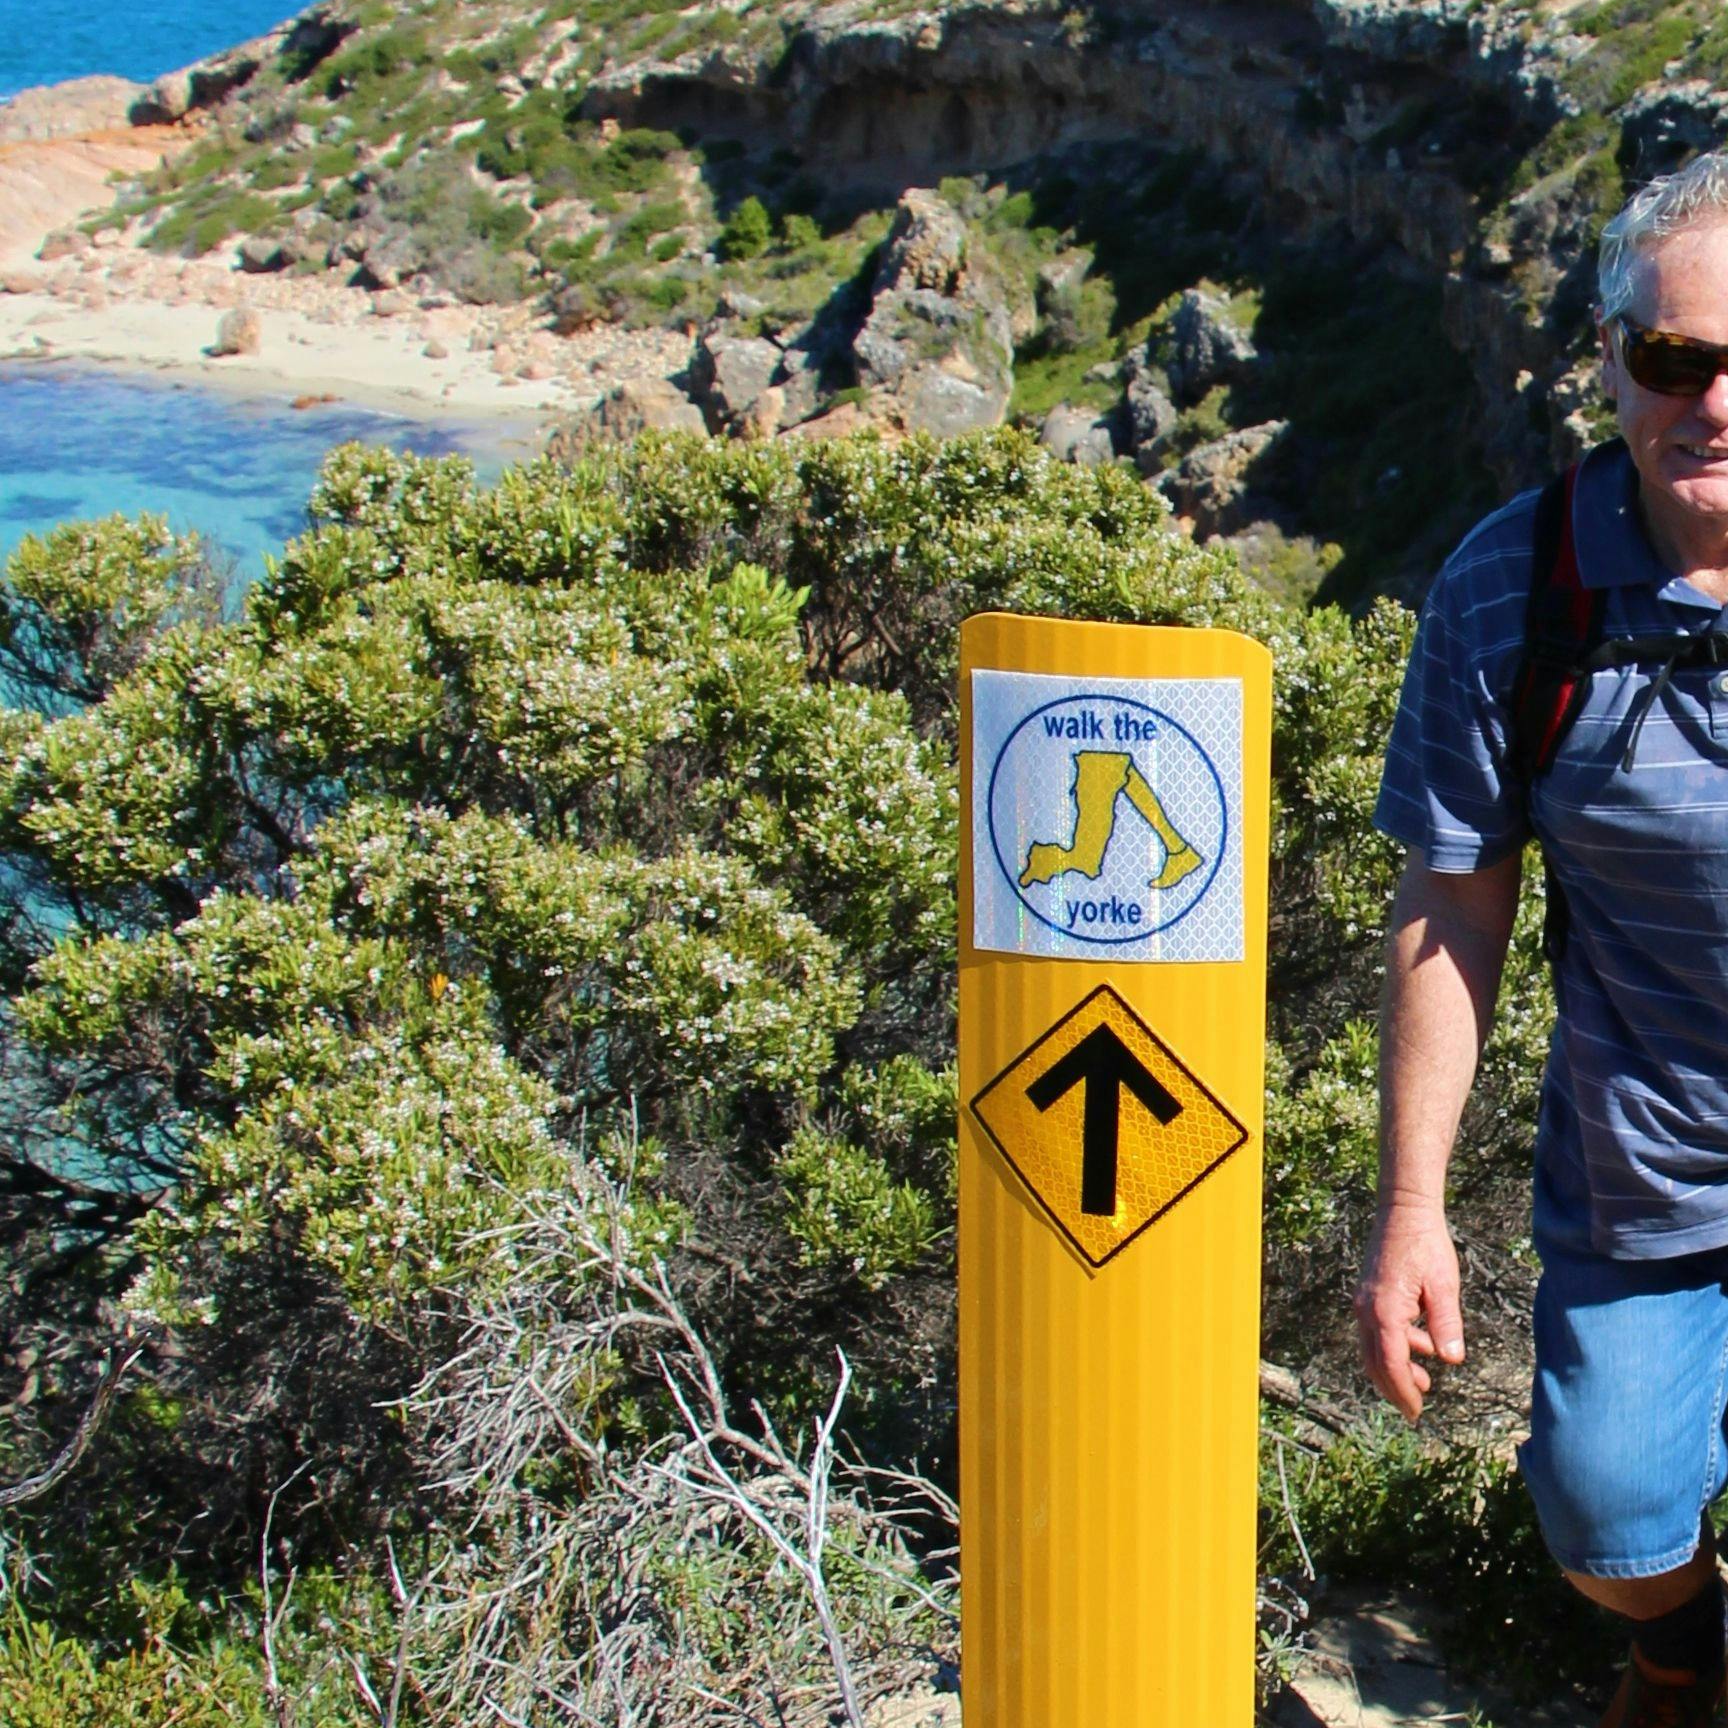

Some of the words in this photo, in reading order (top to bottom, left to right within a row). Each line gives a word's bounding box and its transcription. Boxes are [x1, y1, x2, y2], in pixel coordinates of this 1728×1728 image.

[1043, 710, 1104, 740] walk
[1113, 712, 1157, 741] the
[1066, 895, 1142, 929] yorke
